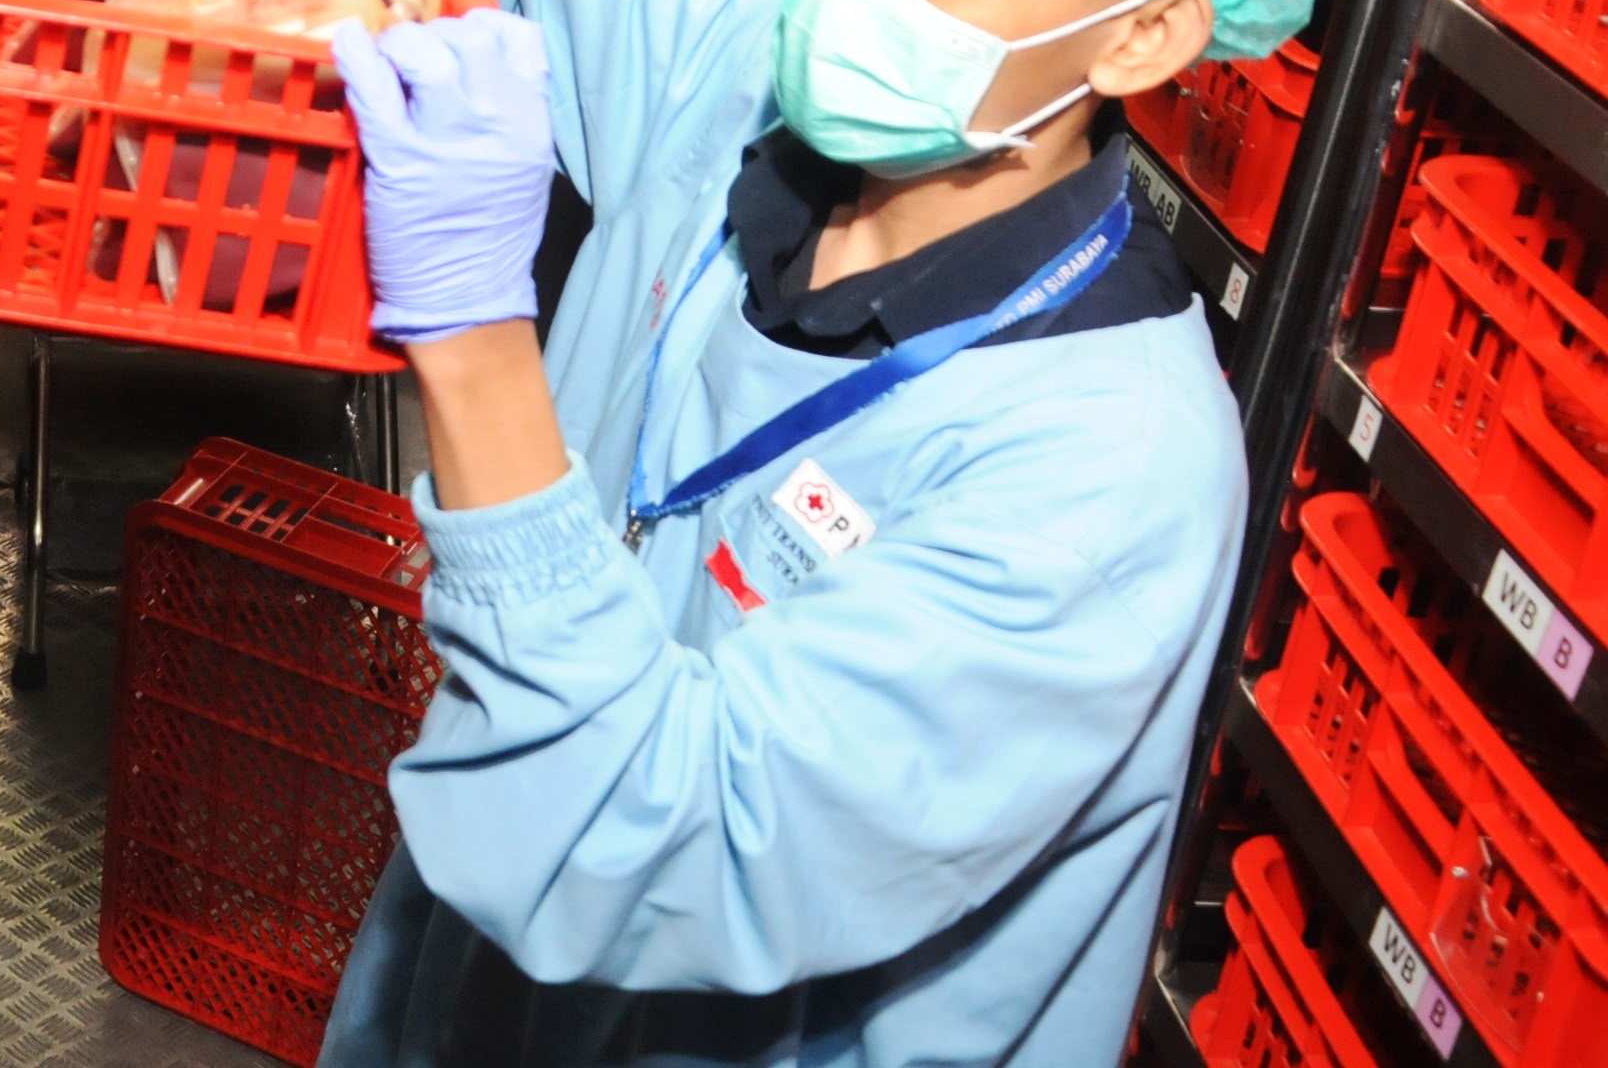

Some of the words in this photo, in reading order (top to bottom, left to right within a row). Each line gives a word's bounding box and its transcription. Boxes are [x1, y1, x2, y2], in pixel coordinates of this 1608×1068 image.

[1156, 193, 1176, 227] AB
[1016, 287, 1048, 316] PMI
[1042, 233, 1109, 295] SURABAYA
[1230, 278, 1241, 304] 8
[1359, 413, 1373, 442] 5
[1499, 570, 1538, 631] WB
[1553, 636, 1573, 670] B
[1384, 922, 1416, 984] WB
[1430, 998, 1447, 1029] B
